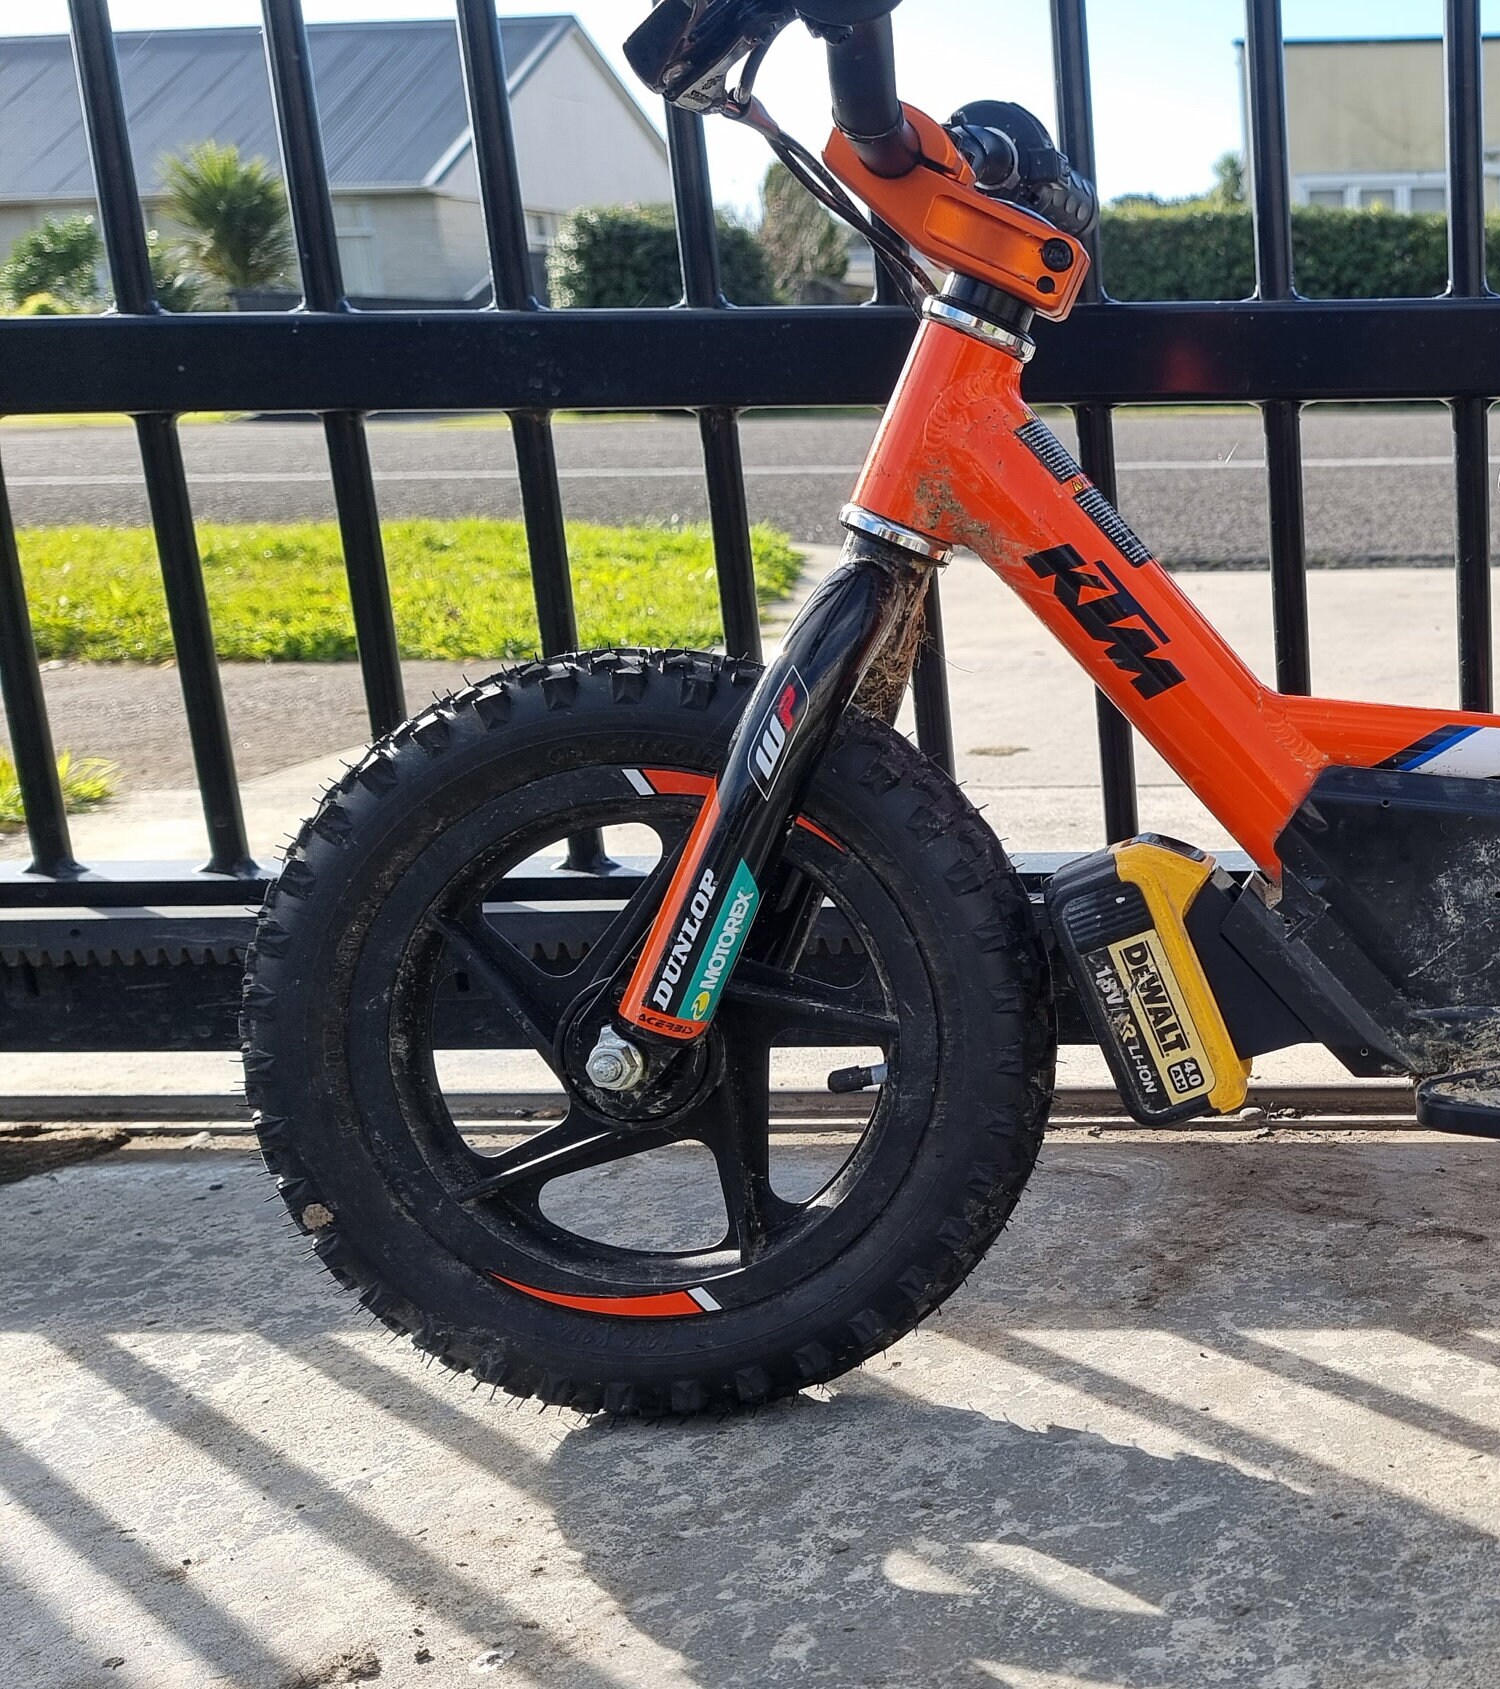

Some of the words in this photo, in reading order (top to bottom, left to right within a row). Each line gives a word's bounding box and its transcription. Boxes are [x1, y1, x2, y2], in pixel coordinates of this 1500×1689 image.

[1023, 543, 1186, 700] KTM
[653, 868, 715, 1011] DUNLOP
[700, 890, 754, 990] MOTOREX
[1123, 941, 1186, 1053] DEWALT
[1183, 1060, 1201, 1085] 4.0
